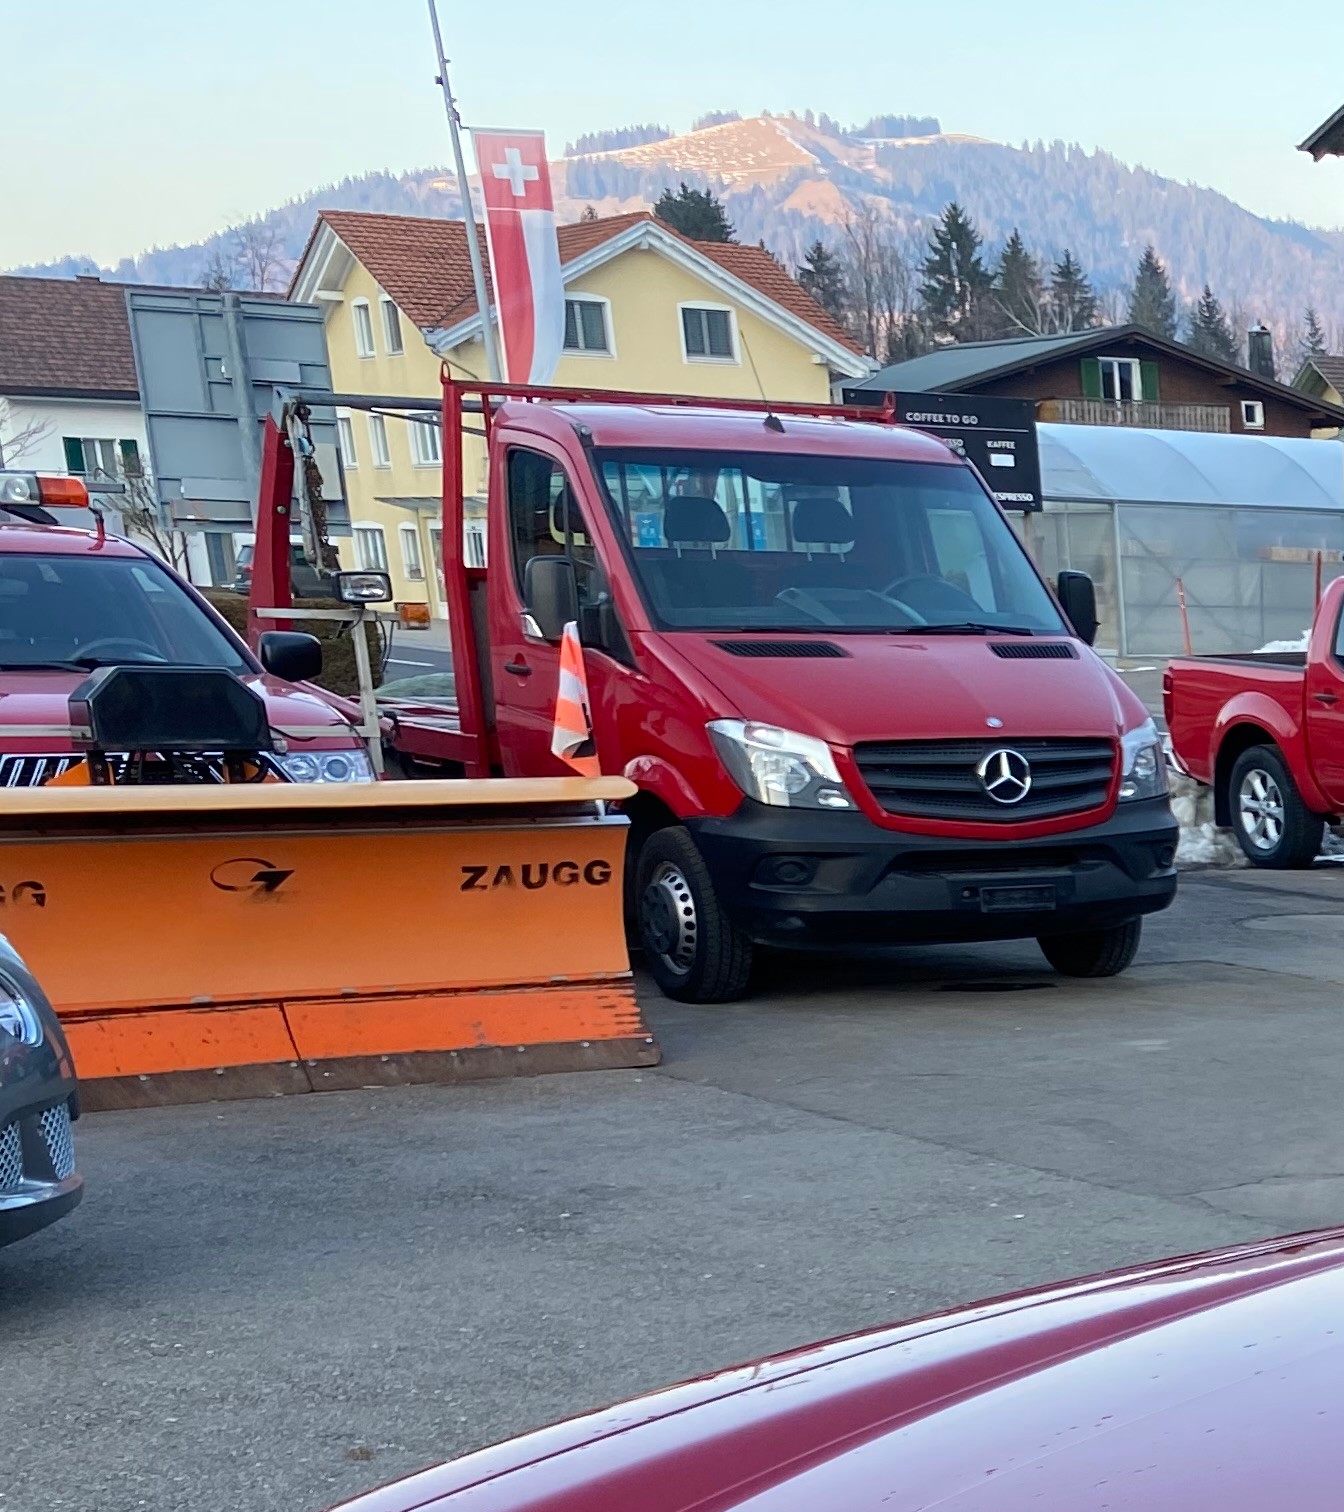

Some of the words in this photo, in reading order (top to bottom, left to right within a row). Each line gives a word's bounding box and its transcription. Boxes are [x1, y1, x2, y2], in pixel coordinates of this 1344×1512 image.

[905, 411, 944, 423] COFFEE
[946, 414, 960, 424] TO
[961, 415, 979, 425] GO
[986, 440, 1016, 450] KAFFEE
[460, 859, 612, 892] ZAUGG
